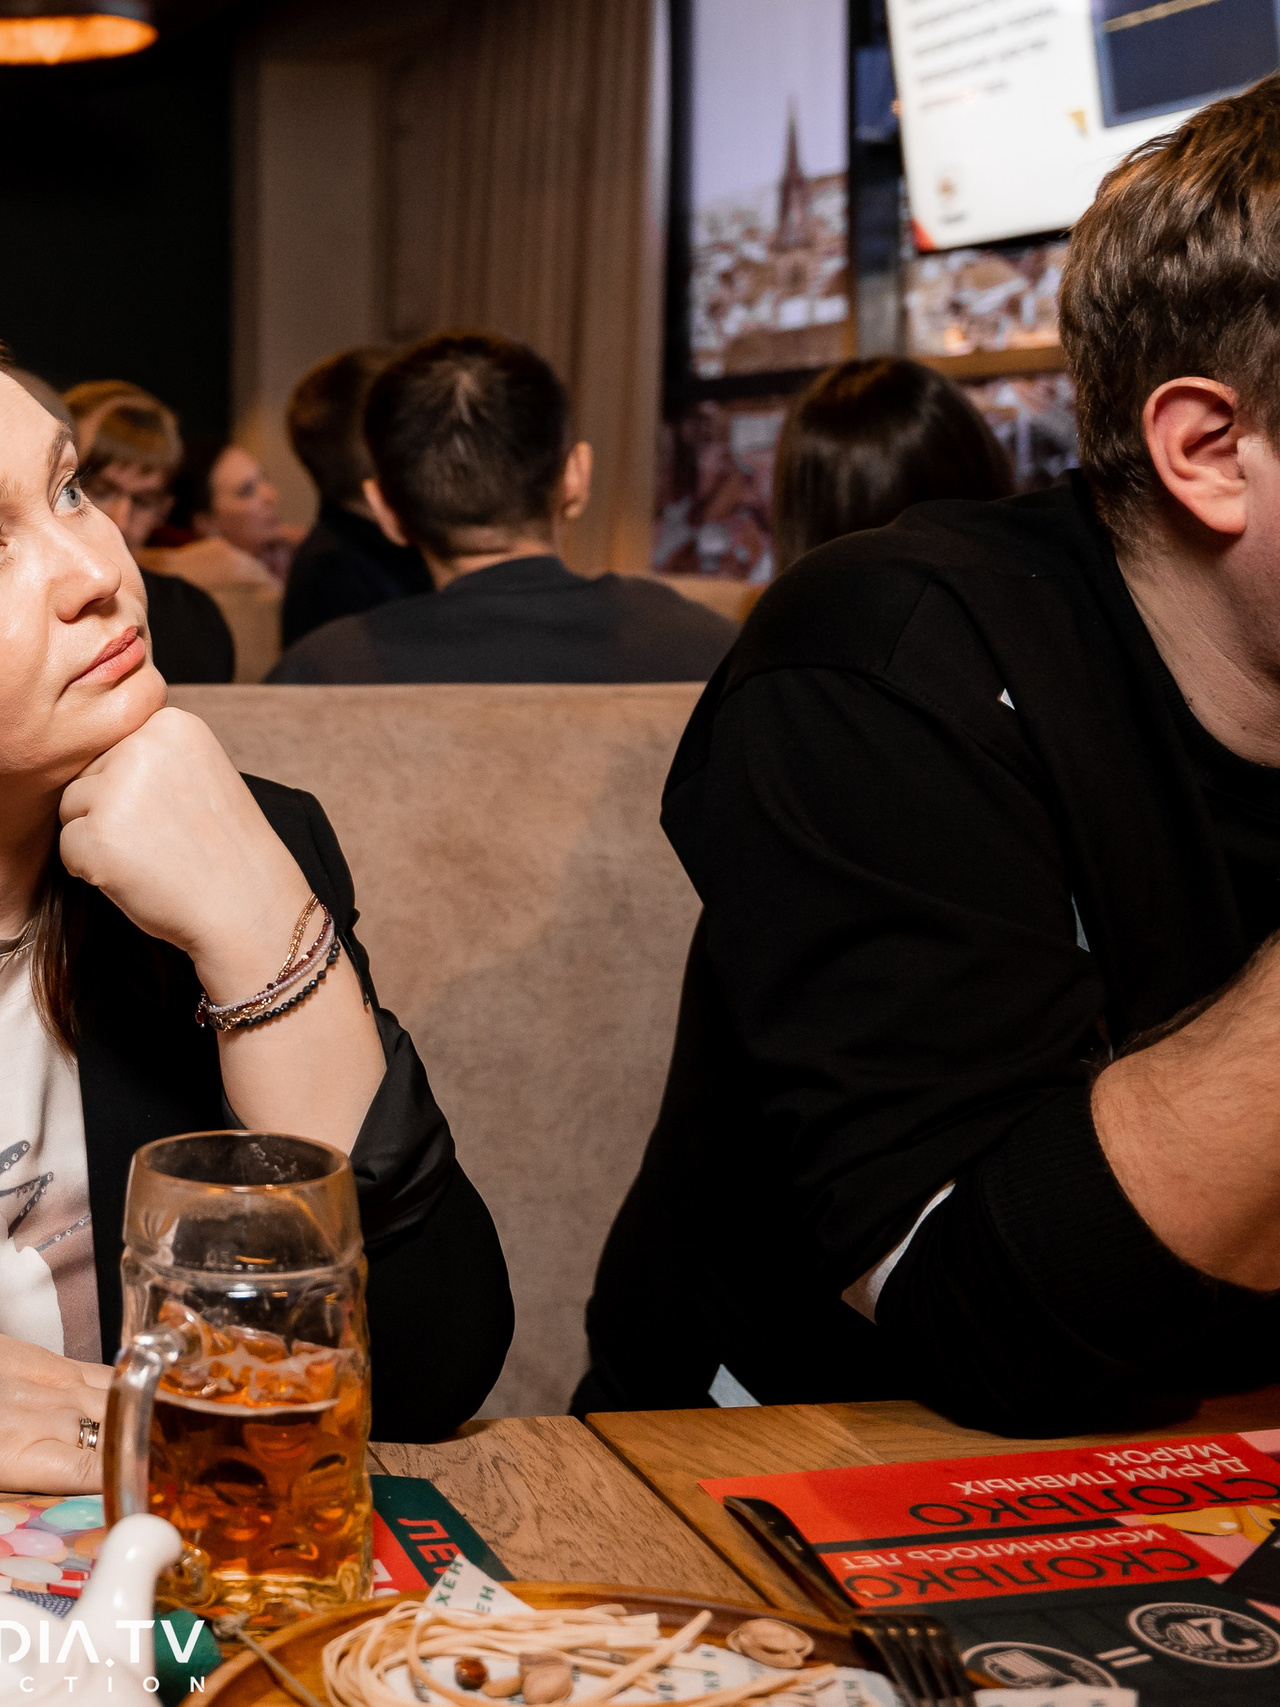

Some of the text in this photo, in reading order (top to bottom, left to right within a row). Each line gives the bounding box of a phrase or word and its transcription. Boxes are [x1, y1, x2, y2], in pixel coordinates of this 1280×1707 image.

[951, 1456, 1251, 1495] ДАРИМ ПИВНЫХ
[1094, 1442, 1230, 1467] МАРОК
[908, 1477, 1280, 1526] СТОЛЬКО
[397, 1518, 467, 1574] ЛЕ
[840, 1529, 1166, 1570] ИСПОЛНИЛОСЬ ЛЕТ
[843, 1548, 1200, 1599] СКОЛЬКО
